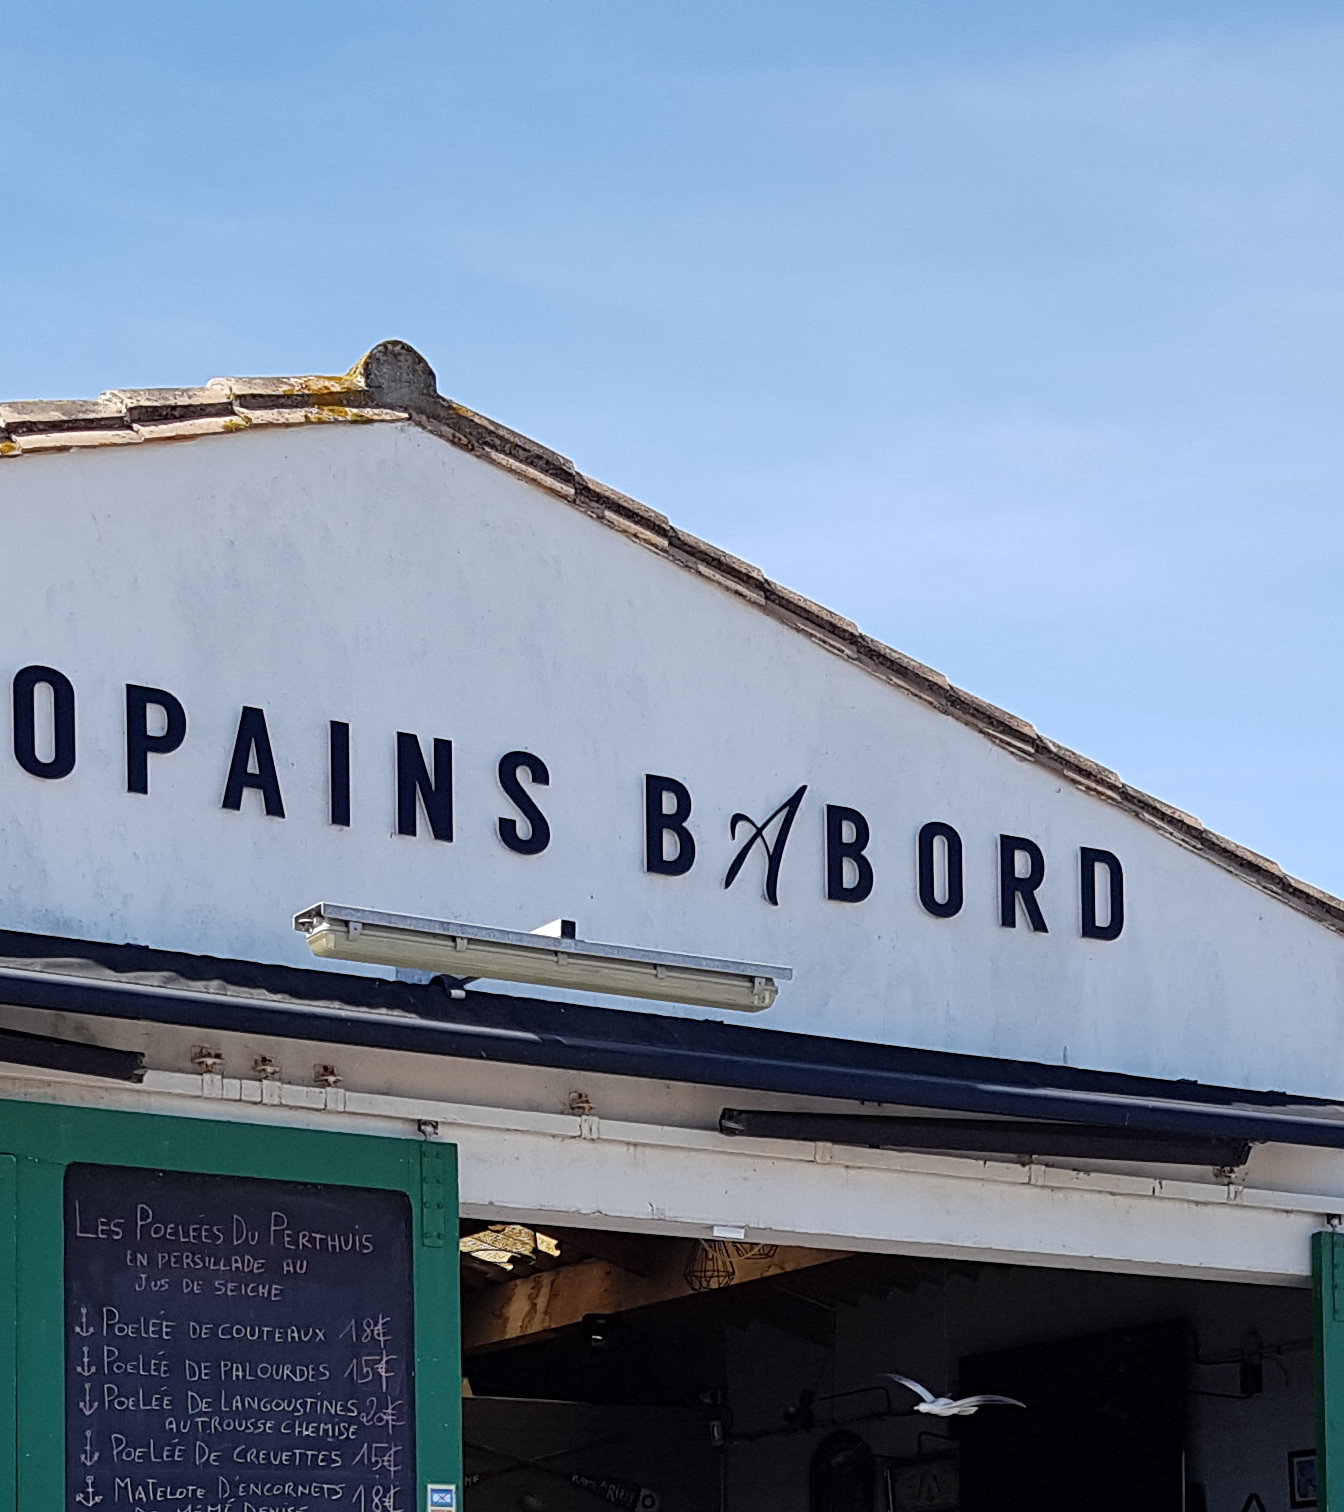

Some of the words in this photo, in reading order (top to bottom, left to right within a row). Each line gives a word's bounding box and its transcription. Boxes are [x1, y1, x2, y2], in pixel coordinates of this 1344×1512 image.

[644, 772, 1126, 942] BABORD
[75, 1199, 124, 1240] LES
[232, 1214, 259, 1247] DU
[270, 1210, 374, 1254] PERTHUIS
[127, 1251, 149, 1267] EN
[158, 1251, 267, 1274] PERSILLADE
[283, 1259, 308, 1275] AU
[135, 1274, 170, 1292] JUS
[183, 1279, 203, 1295] DE
[214, 1280, 285, 1300] SEICHE
[189, 1321, 214, 1339] DE
[218, 1324, 327, 1342] COUTEAUX
[339, 1313, 393, 1348] 18€
[185, 1359, 211, 1381] DE
[220, 1360, 331, 1383] PALOURDES
[343, 1350, 398, 1392] 15€
[188, 1390, 213, 1415] DE
[221, 1389, 359, 1417] LANGOUSTINES
[165, 1417, 191, 1433] AU
[195, 1440, 222, 1466] DE
[233, 1444, 343, 1468] CREVETTES
[115, 1477, 207, 1504] MATELOTE
